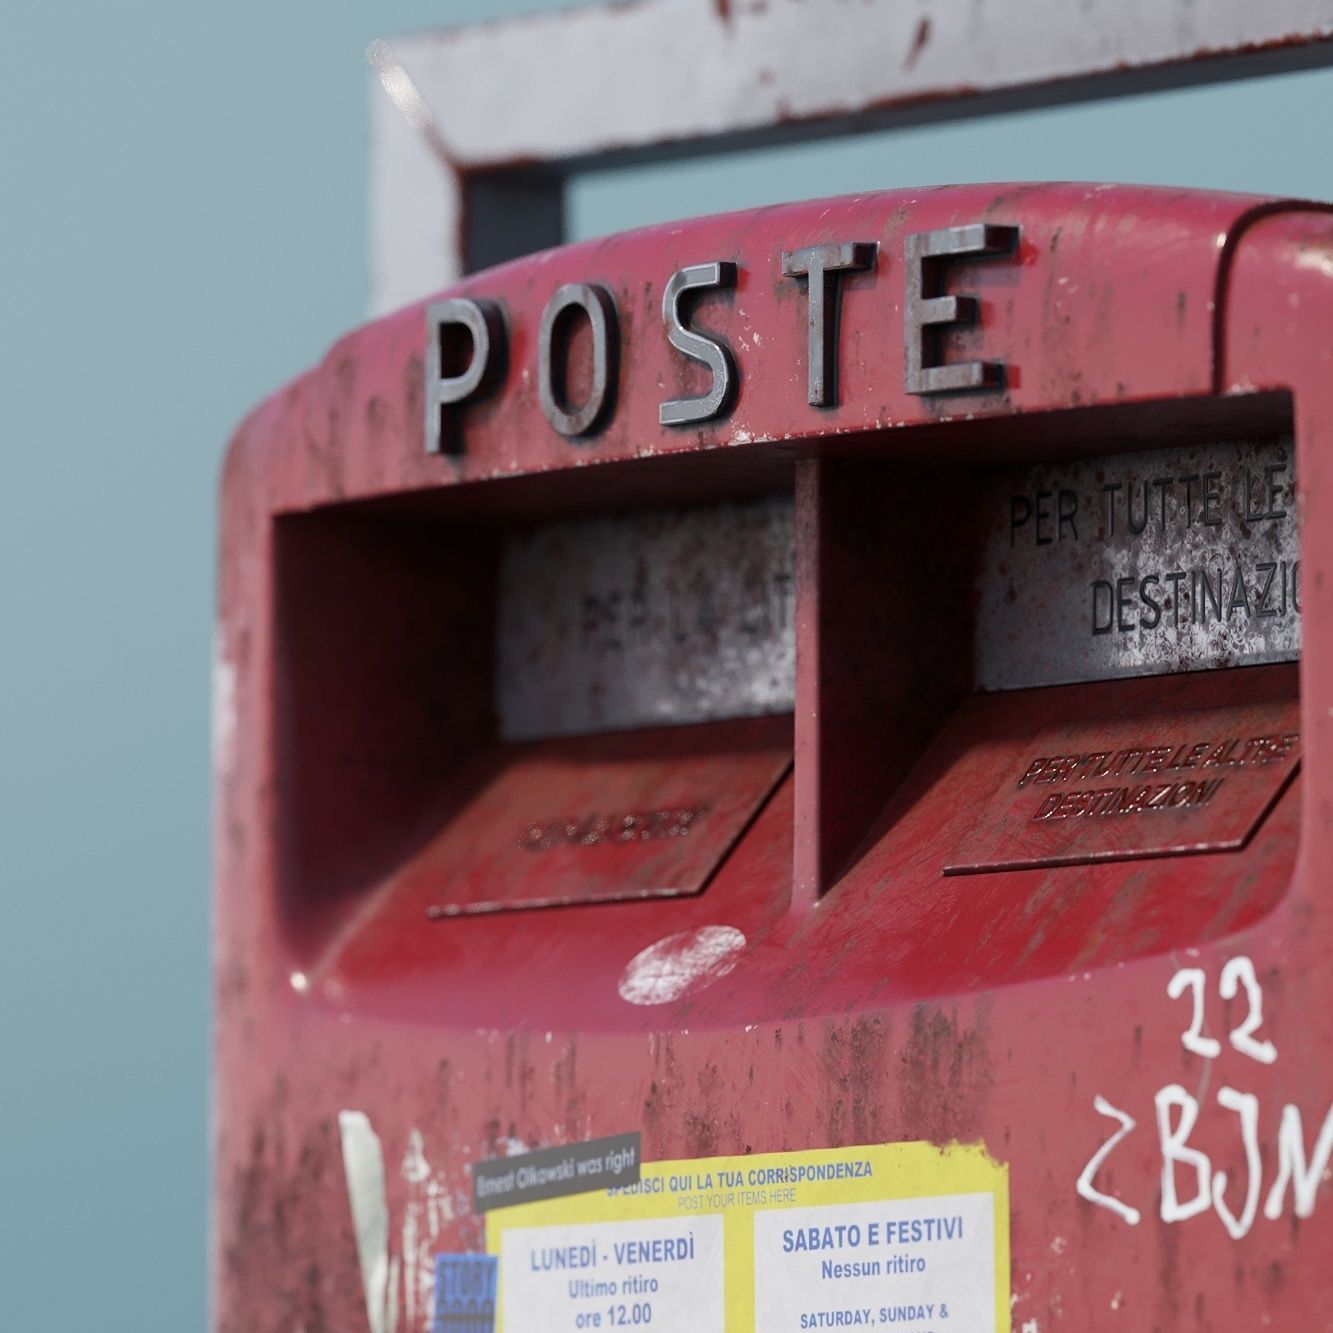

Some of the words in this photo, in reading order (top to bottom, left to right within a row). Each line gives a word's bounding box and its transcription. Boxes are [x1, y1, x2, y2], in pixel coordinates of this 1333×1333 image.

[425, 223, 1020, 455] POSTE
[1010, 488, 1079, 547] PER
[1102, 470, 1222, 536] TUTTE
[1247, 463, 1287, 523] LE
[1018, 757, 1079, 789] PER
[1081, 746, 1171, 781] TUTTE
[1169, 743, 1209, 771] LE
[1203, 734, 1299, 768] ALTRE
[1033, 778, 1224, 821] DESTINAZIONI
[1167, 955, 1278, 1065] 22
[577, 1155, 603, 1177] was
[605, 1147, 635, 1174] right
[669, 1174, 692, 1192] QUI
[697, 1173, 713, 1189] LA
[717, 1170, 744, 1188] TUA
[748, 1161, 873, 1186] CORRISPONDENZA
[678, 1194, 703, 1211] POST
[706, 1192, 734, 1208] YOUR
[737, 1190, 767, 1206] ITEMS
[769, 1187, 796, 1203] HERE
[530, 1239, 597, 1271] LUNEDÌ
[614, 1231, 695, 1265] VENERDÌ
[783, 1224, 861, 1253] SABATO
[868, 1223, 880, 1246] E
[886, 1216, 963, 1244] FESTIVI
[821, 1260, 880, 1279] Nessun
[886, 1253, 926, 1274] ritiro
[568, 1278, 617, 1299] Ultimo
[622, 1274, 659, 1295] ritiro
[576, 1312, 601, 1329] ore
[607, 1302, 652, 1326] 12.00
[800, 1308, 875, 1329] SATURDAY,
[879, 1303, 935, 1323] SUNDAY
[939, 1303, 949, 1319] &
